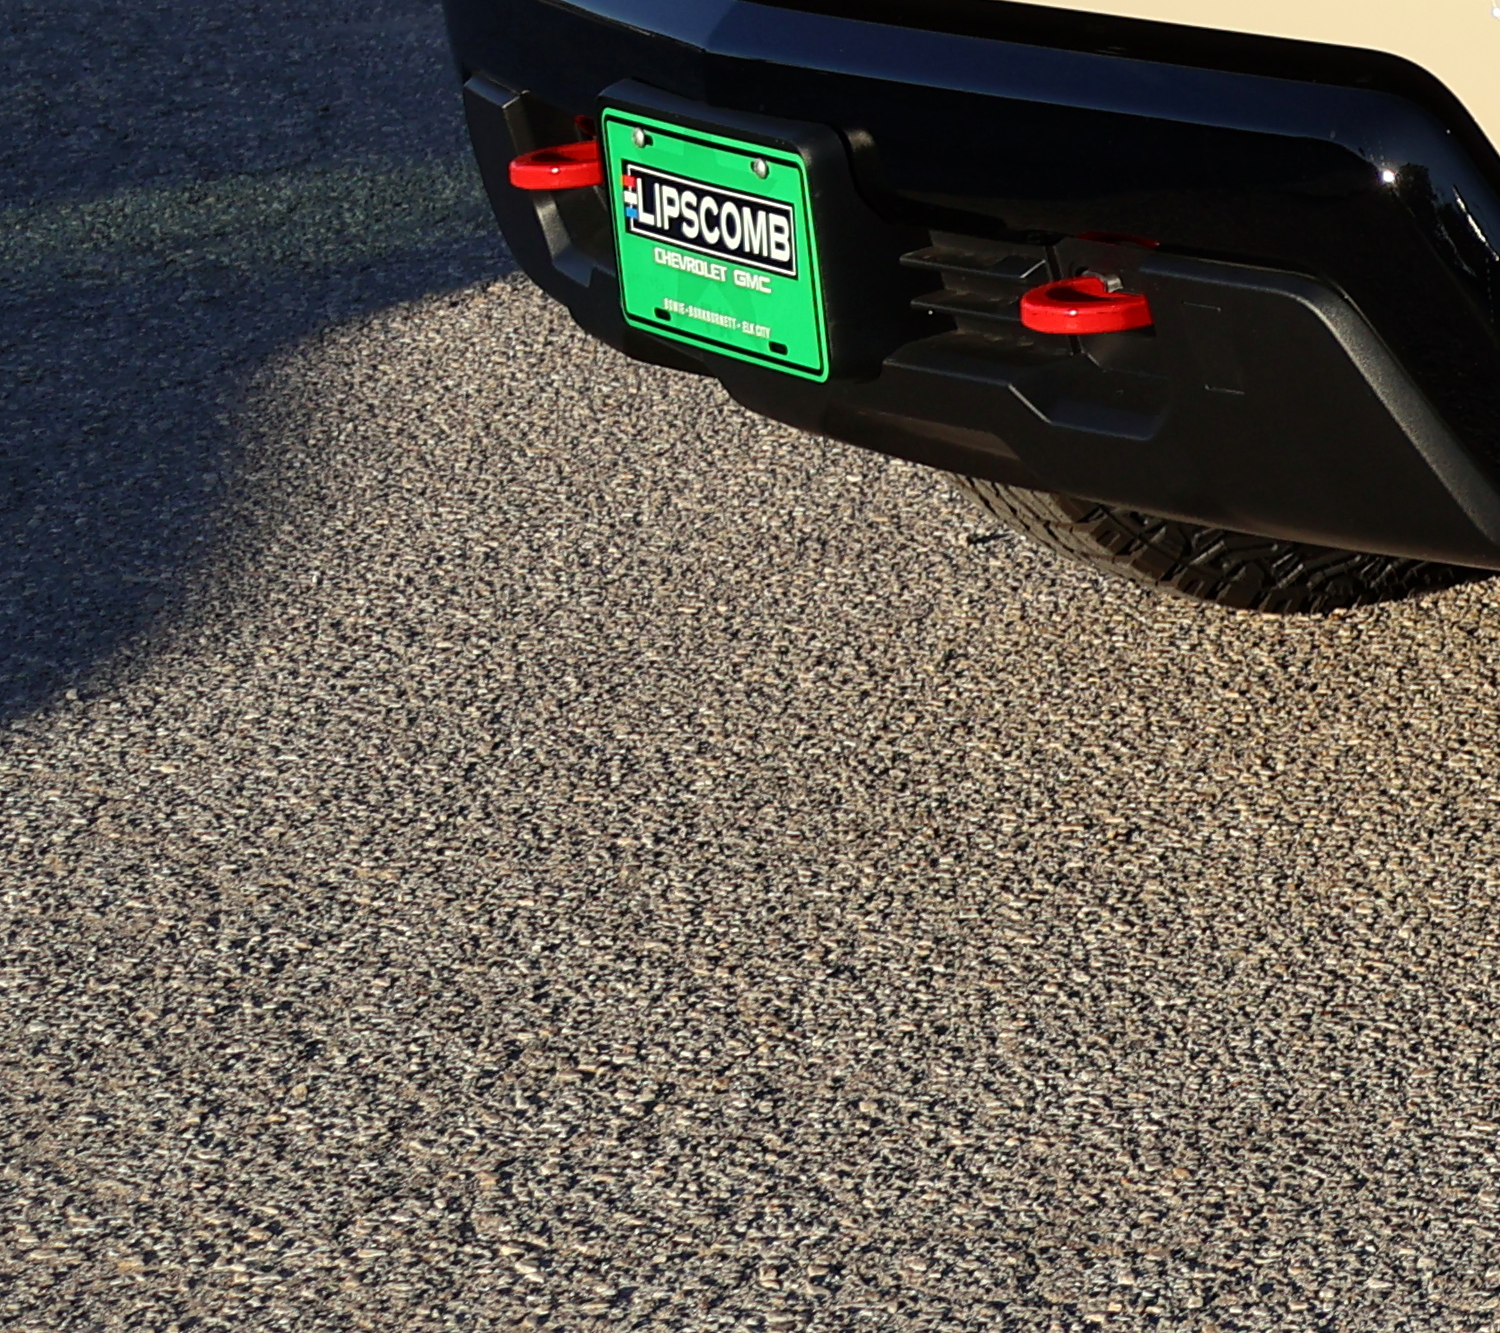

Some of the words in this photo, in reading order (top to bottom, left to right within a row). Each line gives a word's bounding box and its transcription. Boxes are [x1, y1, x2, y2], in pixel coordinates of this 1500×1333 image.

[636, 177, 791, 262] LIPSCOMB
[654, 247, 727, 281] CHEVROLET
[733, 269, 772, 294] GMC
